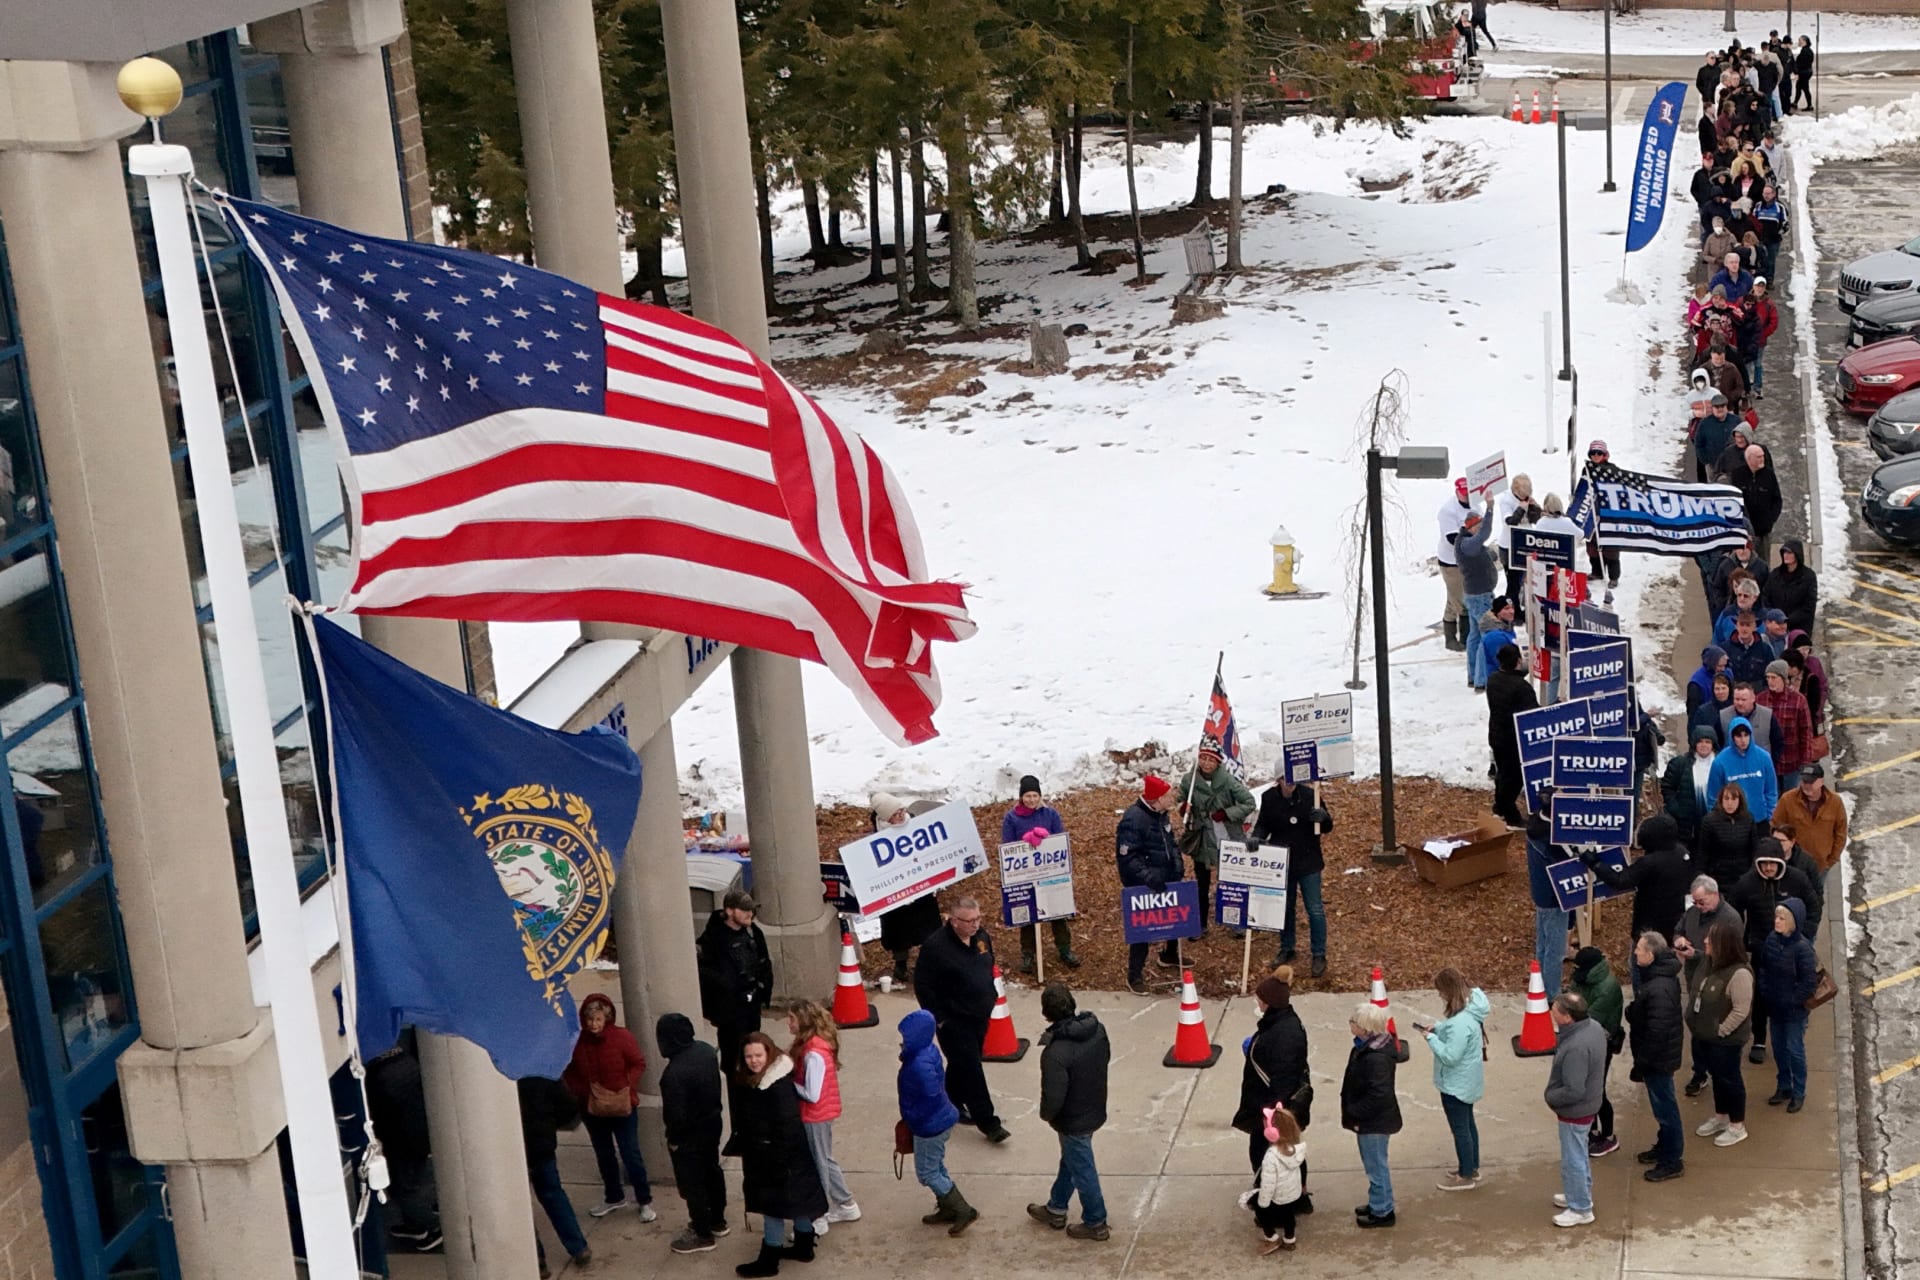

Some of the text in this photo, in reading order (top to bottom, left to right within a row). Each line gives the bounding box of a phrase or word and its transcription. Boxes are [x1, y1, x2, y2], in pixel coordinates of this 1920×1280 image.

[1634, 126, 1659, 223] HANDICAPPED
[1650, 149, 1668, 208] PARKING
[1597, 482, 1742, 519] TRUMP
[1525, 534, 1559, 549] Dean
[1548, 608, 1574, 628] NIKI
[1573, 660, 1624, 680] TRUMP
[1286, 708, 1349, 724] JOE BIDEN
[1592, 709, 1624, 725] UMP
[1524, 717, 1586, 744] TRUMP
[1559, 755, 1628, 769] TRUMP
[1558, 813, 1626, 827] TRUMP
[869, 820, 948, 868] Dean
[485, 823, 545, 848] STATE
[556, 835, 580, 855] OF
[580, 858, 601, 898] NEW
[869, 846, 968, 893] PHILLIPS FOR PRESIDENT
[1004, 849, 1067, 871] JOE BIDEN
[1222, 854, 1284, 870] JOE BIDEN
[1559, 864, 1624, 891] TRUP
[1131, 891, 1178, 911] NIKKI
[1131, 906, 1190, 927] HALEY
